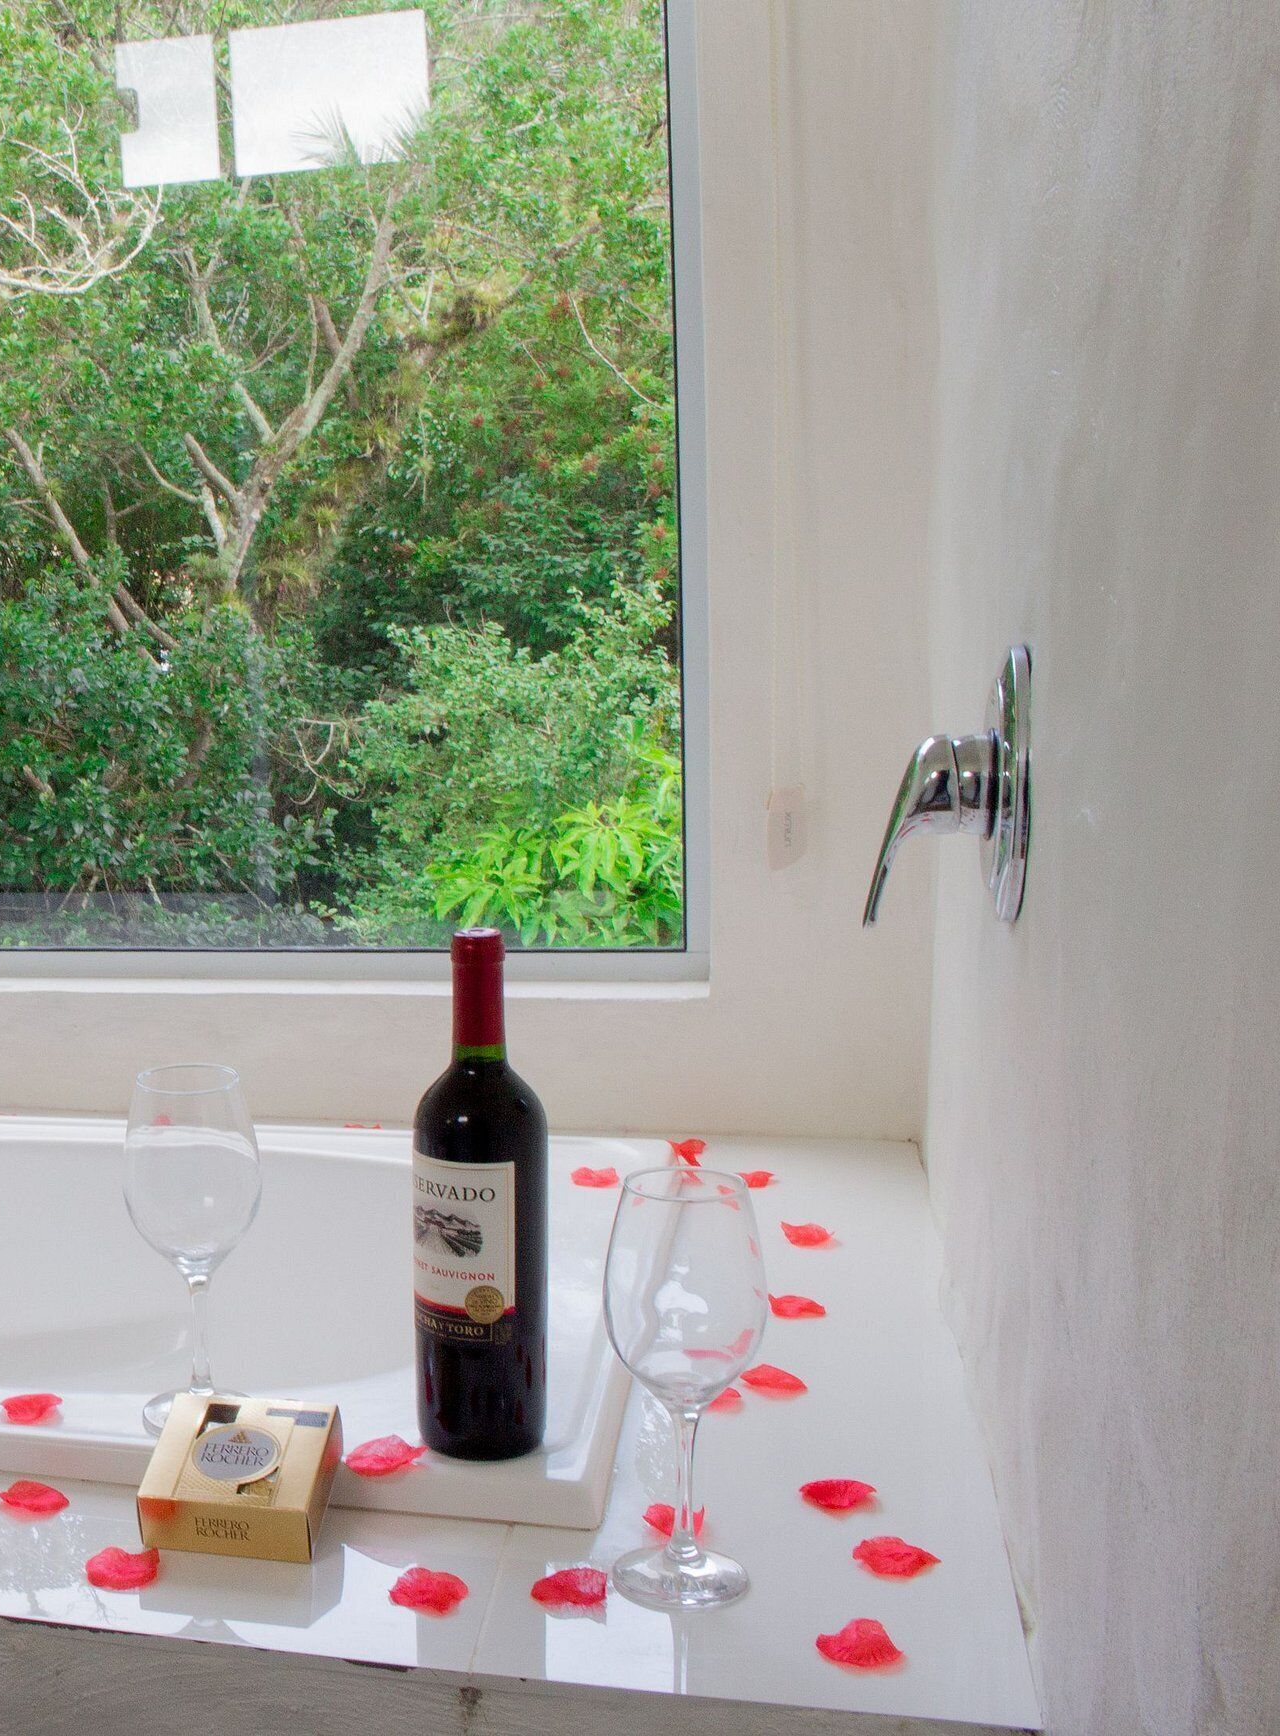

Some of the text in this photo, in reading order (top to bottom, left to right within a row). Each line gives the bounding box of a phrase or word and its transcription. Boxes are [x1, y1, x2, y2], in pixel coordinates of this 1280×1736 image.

[431, 1265, 495, 1280] SAUVIGNON
[448, 1322, 484, 1337] TORO
[203, 1442, 269, 1457] FERRERO
[201, 1452, 264, 1467] ROCHER
[194, 1517, 249, 1530] FERRERO
[196, 1528, 251, 1541] ROCHER
